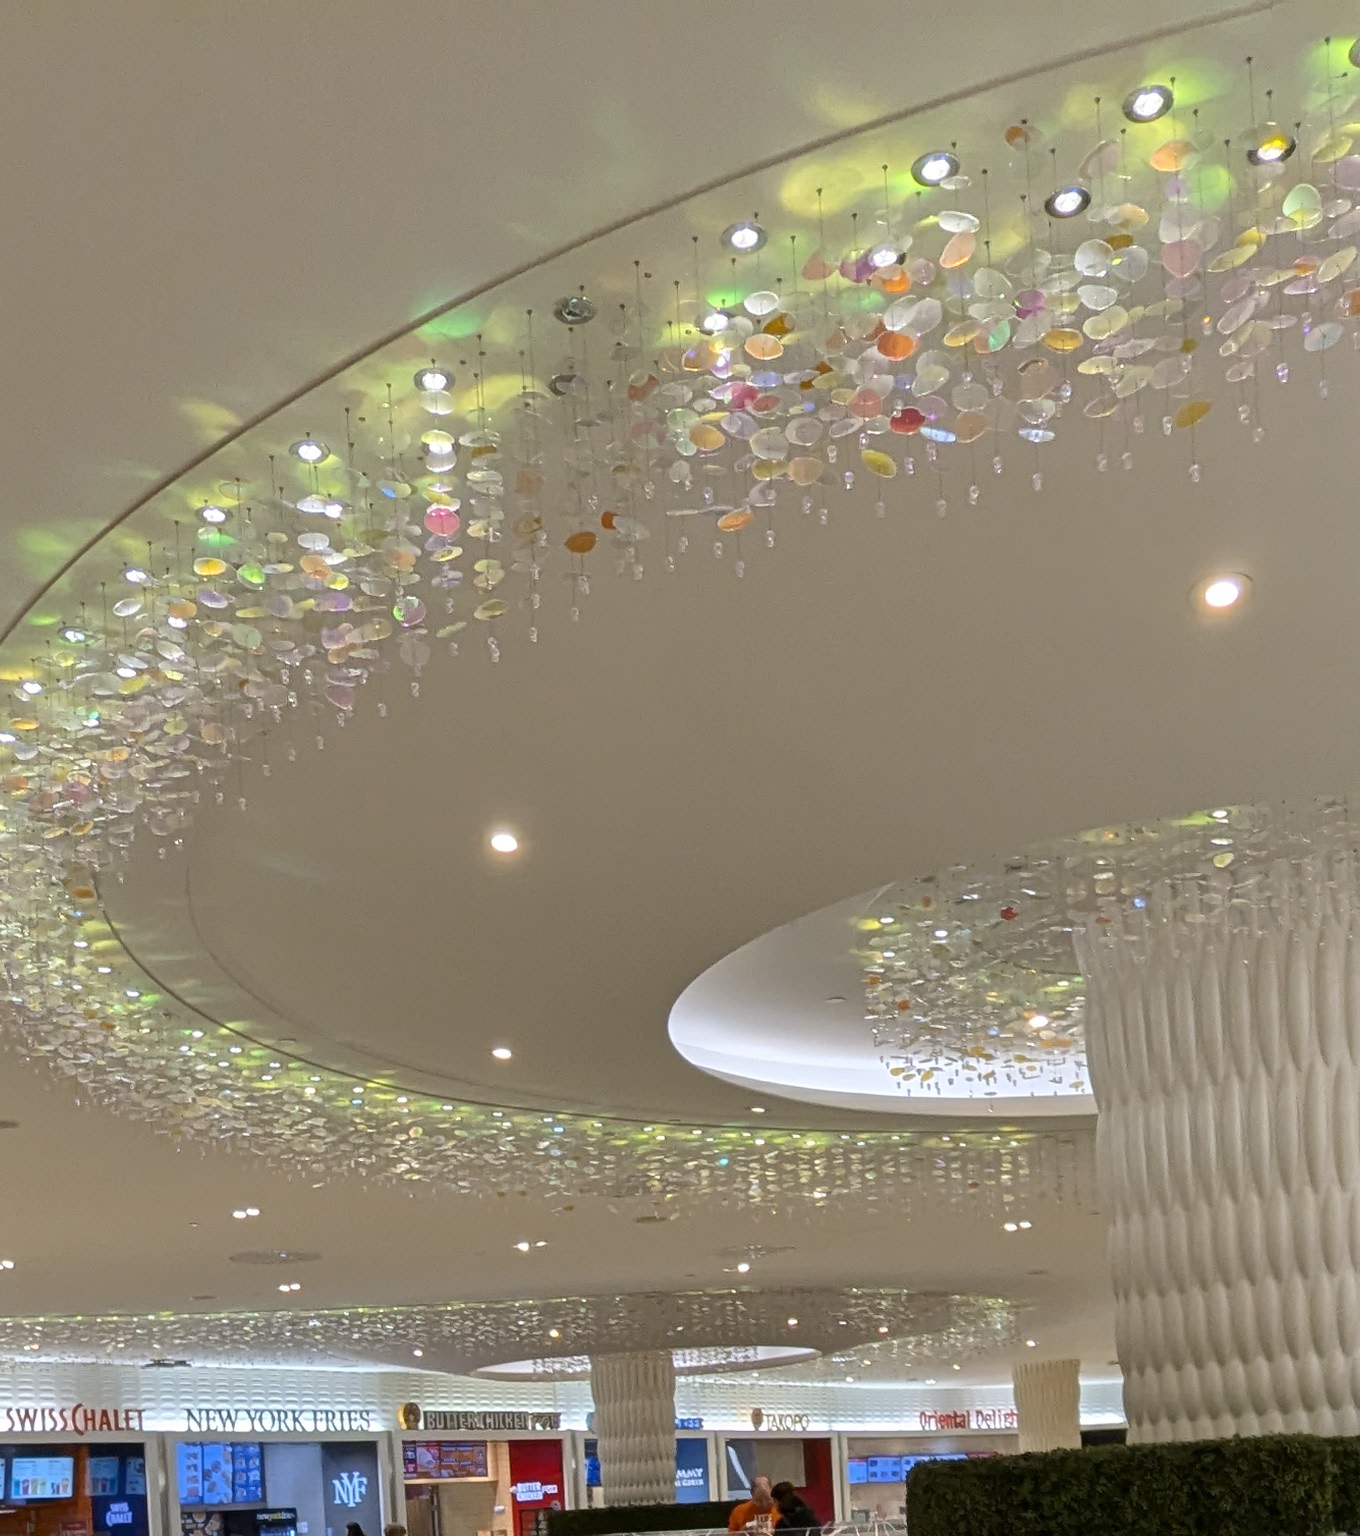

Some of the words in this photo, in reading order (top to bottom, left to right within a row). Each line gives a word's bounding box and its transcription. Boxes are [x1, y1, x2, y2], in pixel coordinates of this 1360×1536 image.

[6, 1407, 68, 1432] SWISS
[71, 1402, 146, 1436] CHALET
[185, 1408, 242, 1432] NEW
[243, 1408, 304, 1432] YORK
[312, 1409, 371, 1432] FRIES
[426, 1412, 476, 1430] BUTTER
[477, 1412, 529, 1430] CHICKEN
[919, 1410, 970, 1431] Oriental
[332, 1471, 368, 1508] NYF
